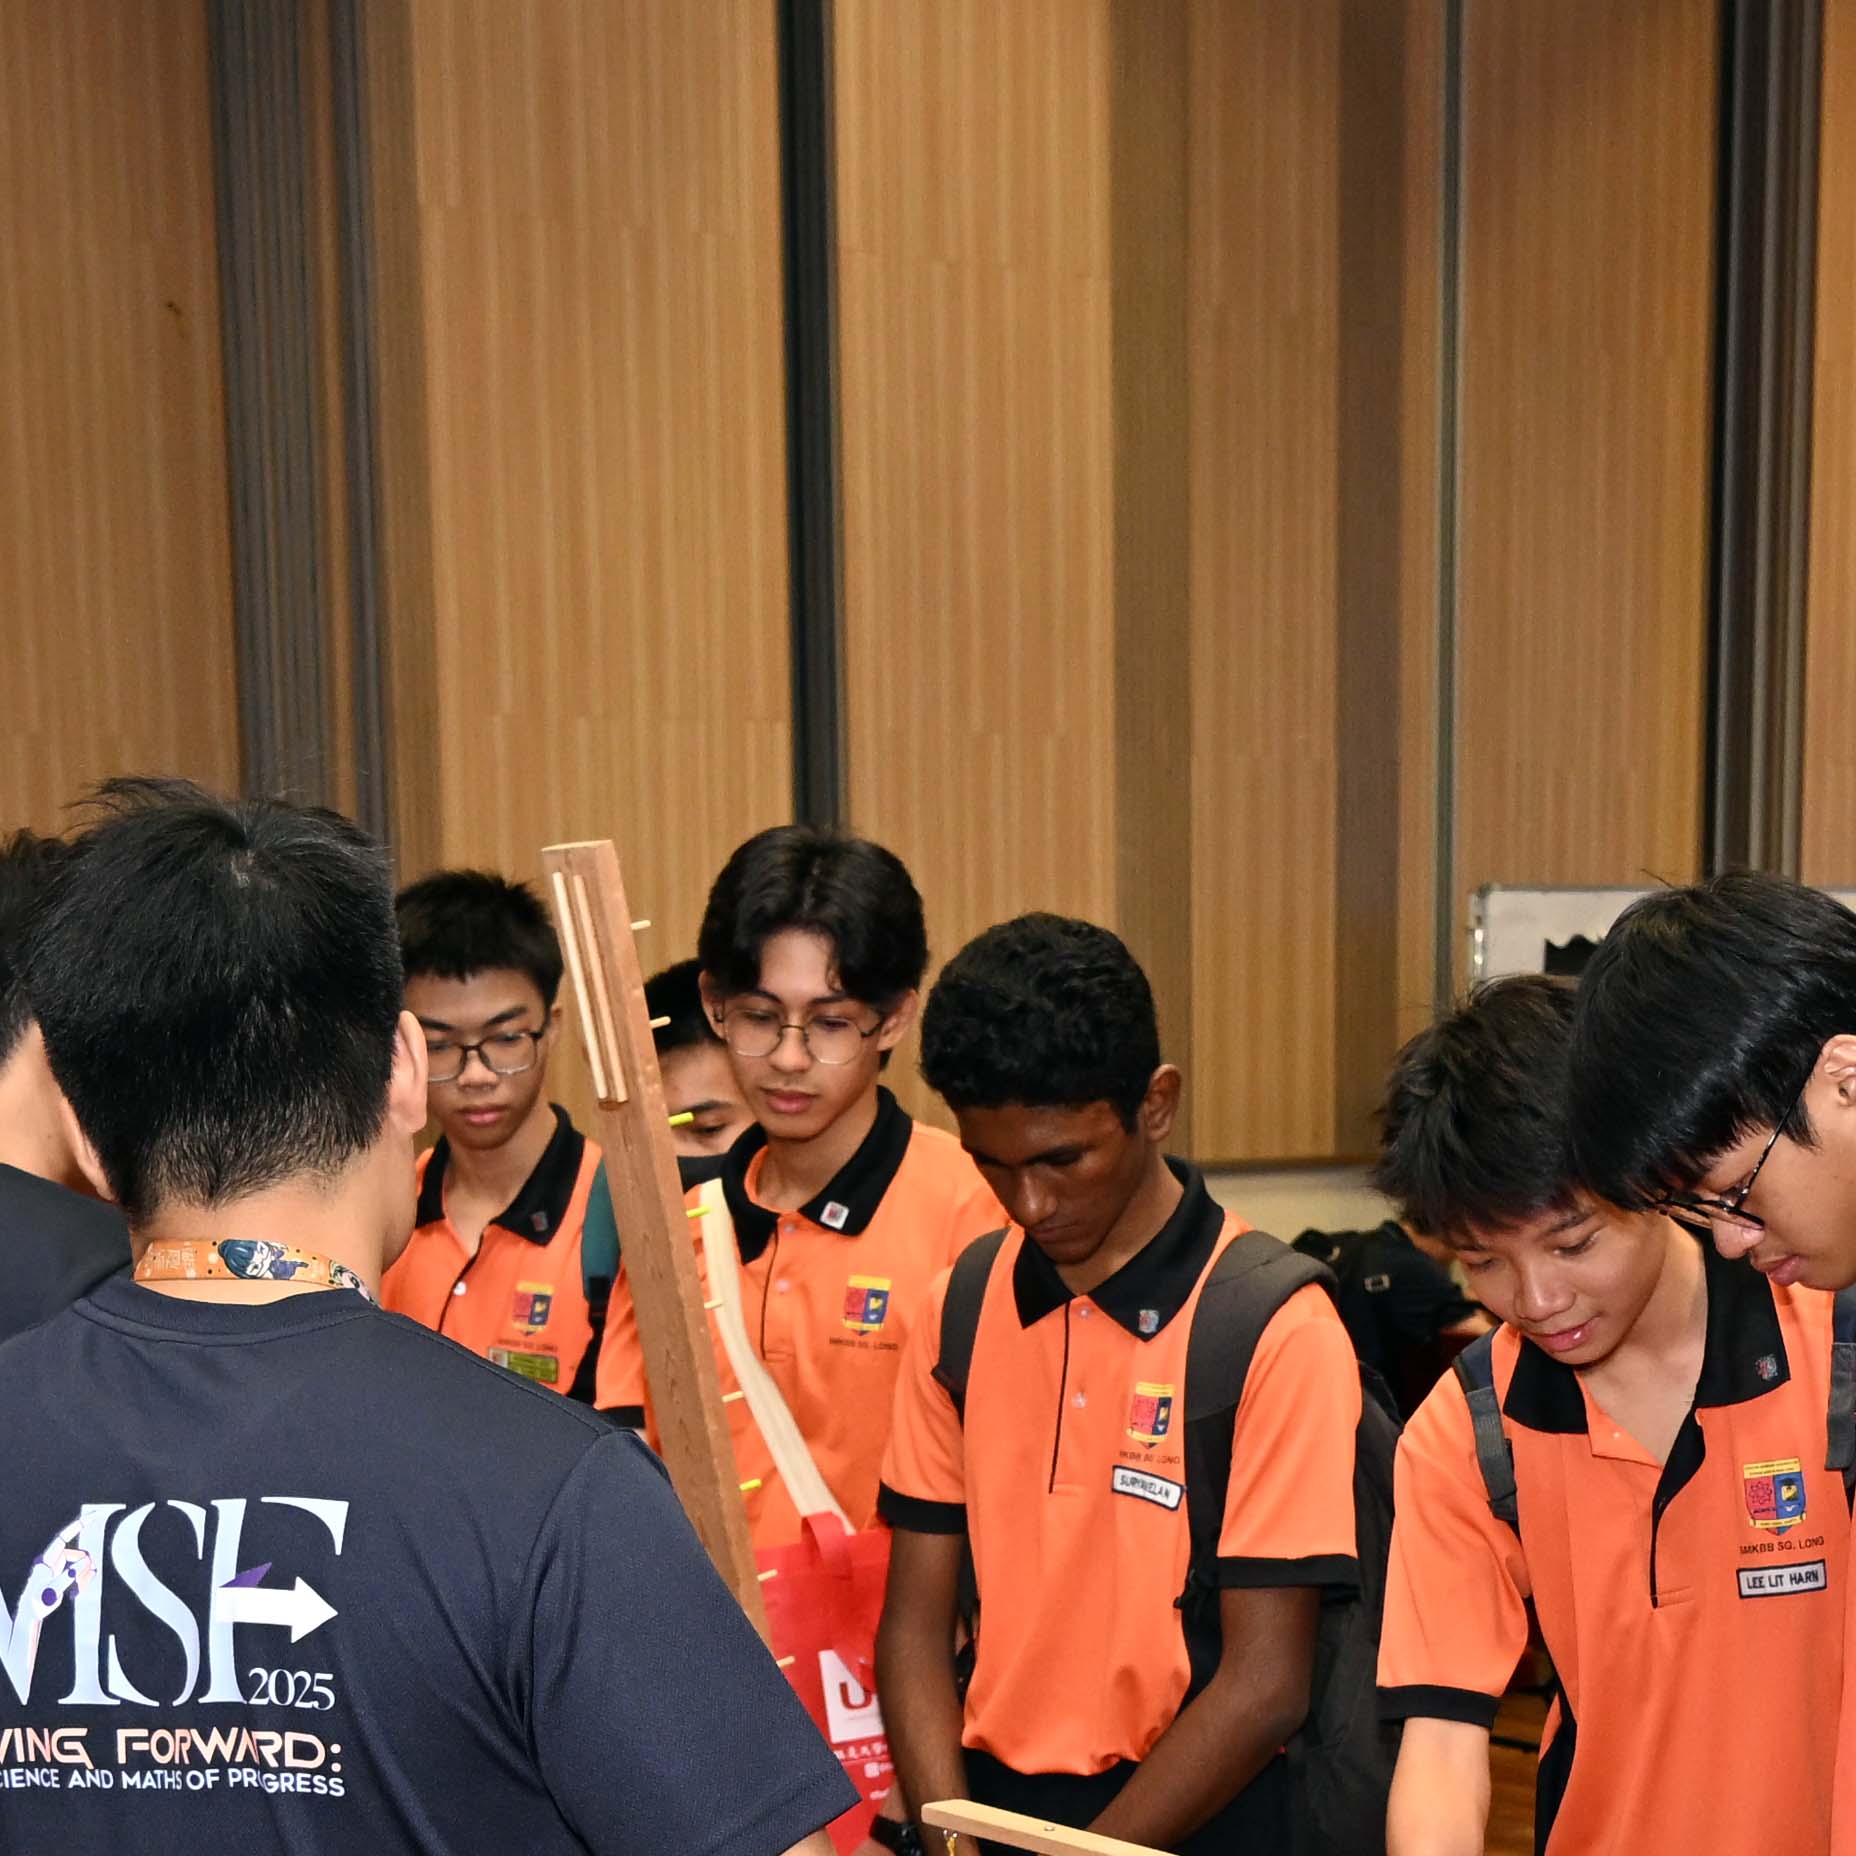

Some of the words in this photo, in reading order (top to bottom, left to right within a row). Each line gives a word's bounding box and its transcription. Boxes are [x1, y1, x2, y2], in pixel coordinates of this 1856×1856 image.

[1746, 1577, 1765, 1589] LEE
[1768, 1574, 1784, 1587] LIT
[1789, 1569, 1819, 1584] HARN
[246, 1667, 336, 1711] 2025
[116, 1726, 343, 1773] FORWARD:
[67, 1768, 114, 1790] AND
[121, 1769, 183, 1791] MATHS
[186, 1768, 220, 1791] OF
